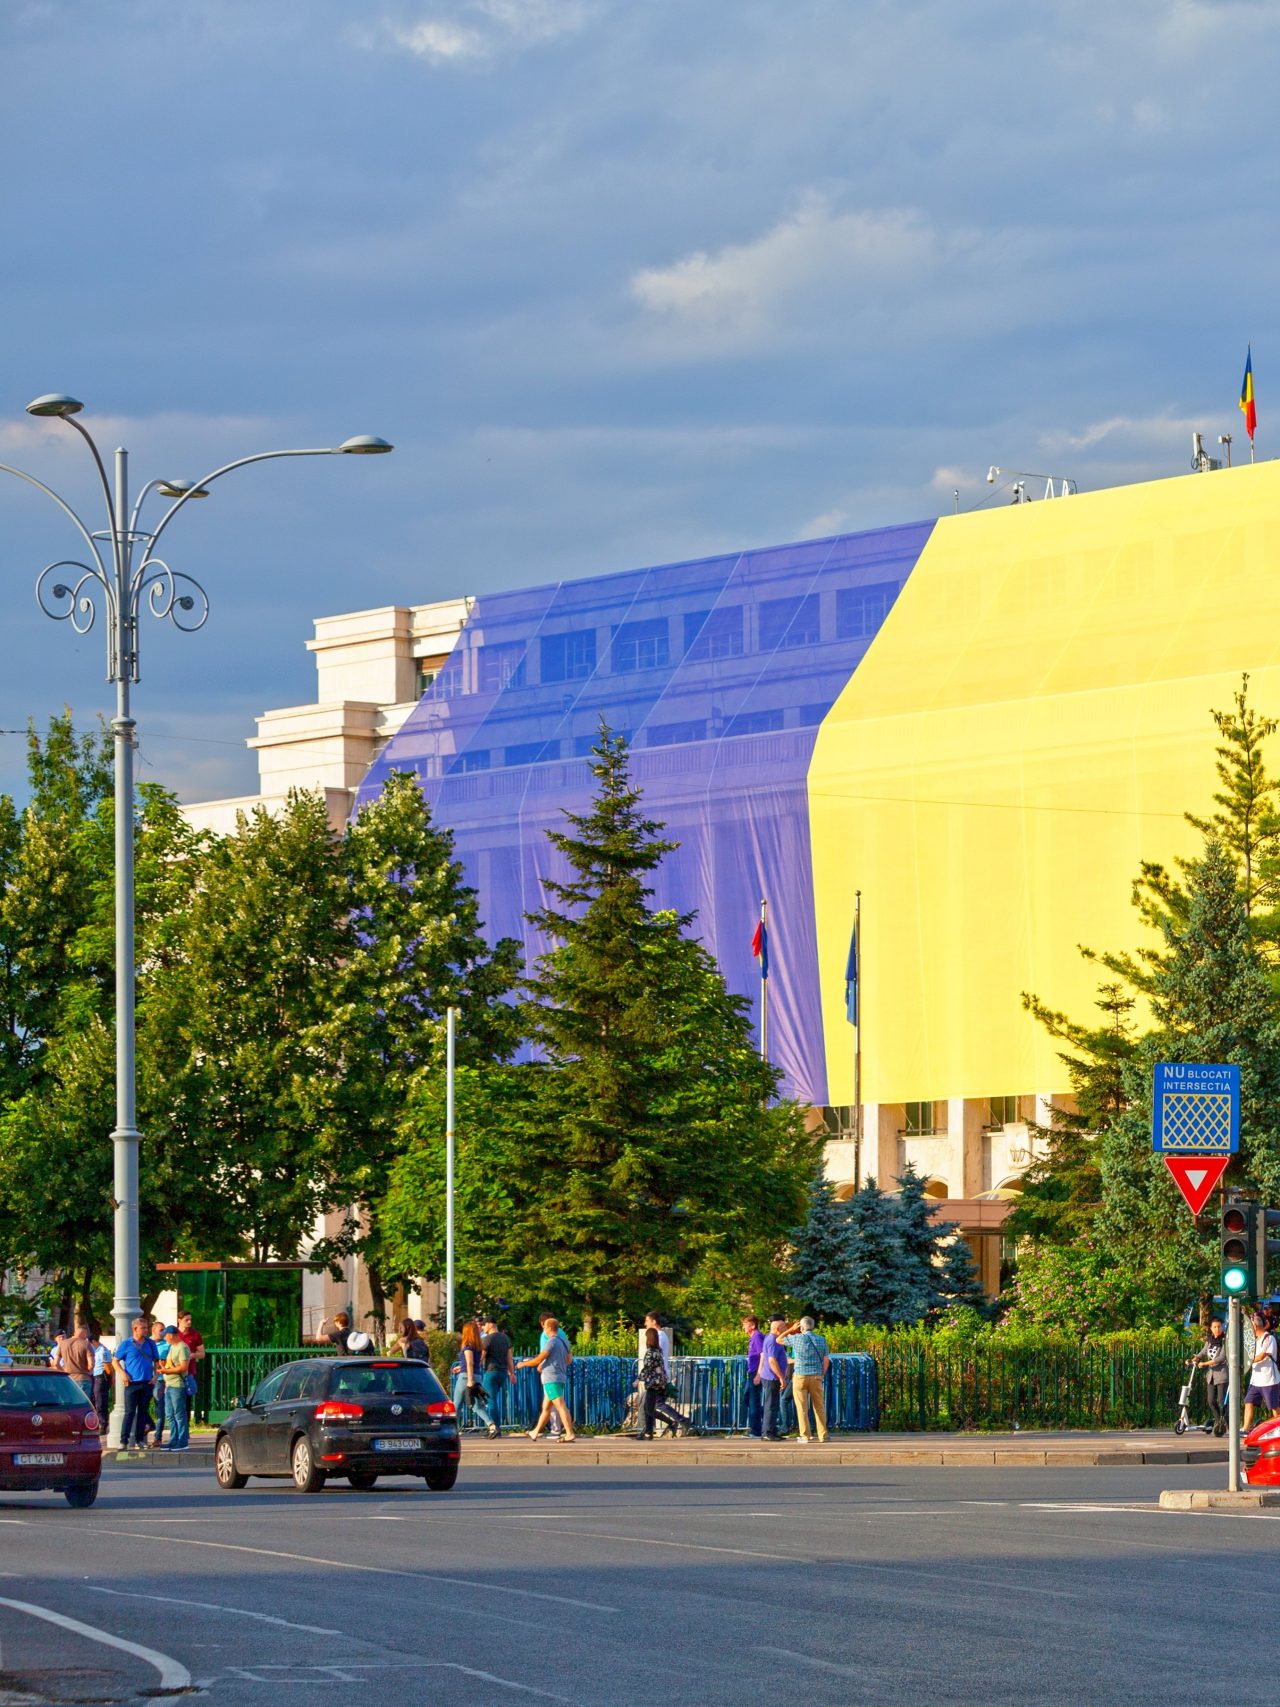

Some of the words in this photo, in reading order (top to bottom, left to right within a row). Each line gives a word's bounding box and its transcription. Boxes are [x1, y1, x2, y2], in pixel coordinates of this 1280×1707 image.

[1164, 1066, 1185, 1078] NU
[1188, 1071, 1231, 1079] BLOCATI
[1163, 1081, 1231, 1091] INTERSECTIA
[379, 1439, 386, 1449] B
